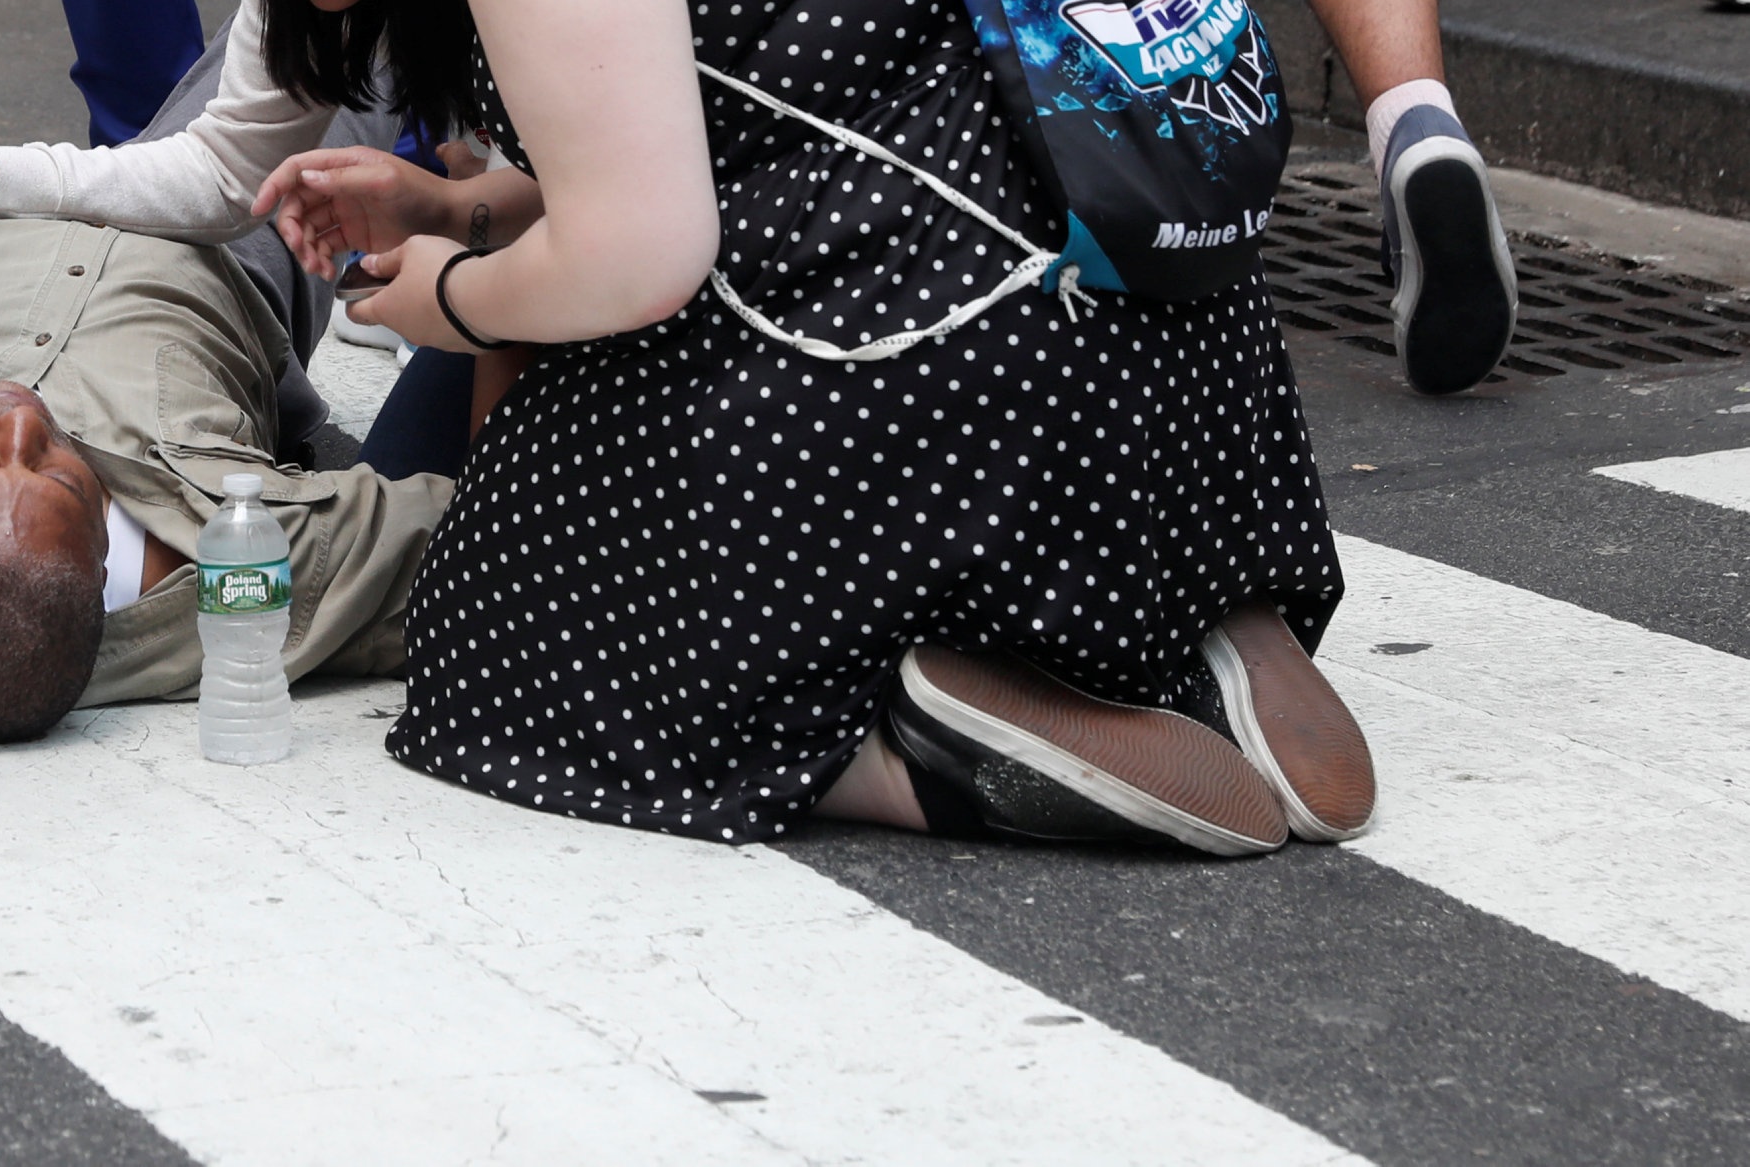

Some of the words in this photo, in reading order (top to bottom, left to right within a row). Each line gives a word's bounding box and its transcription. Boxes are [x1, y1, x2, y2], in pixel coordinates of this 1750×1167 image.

[1151, 221, 1238, 249] Meine
[225, 573, 262, 587] Poland
[222, 584, 267, 604] Spring
